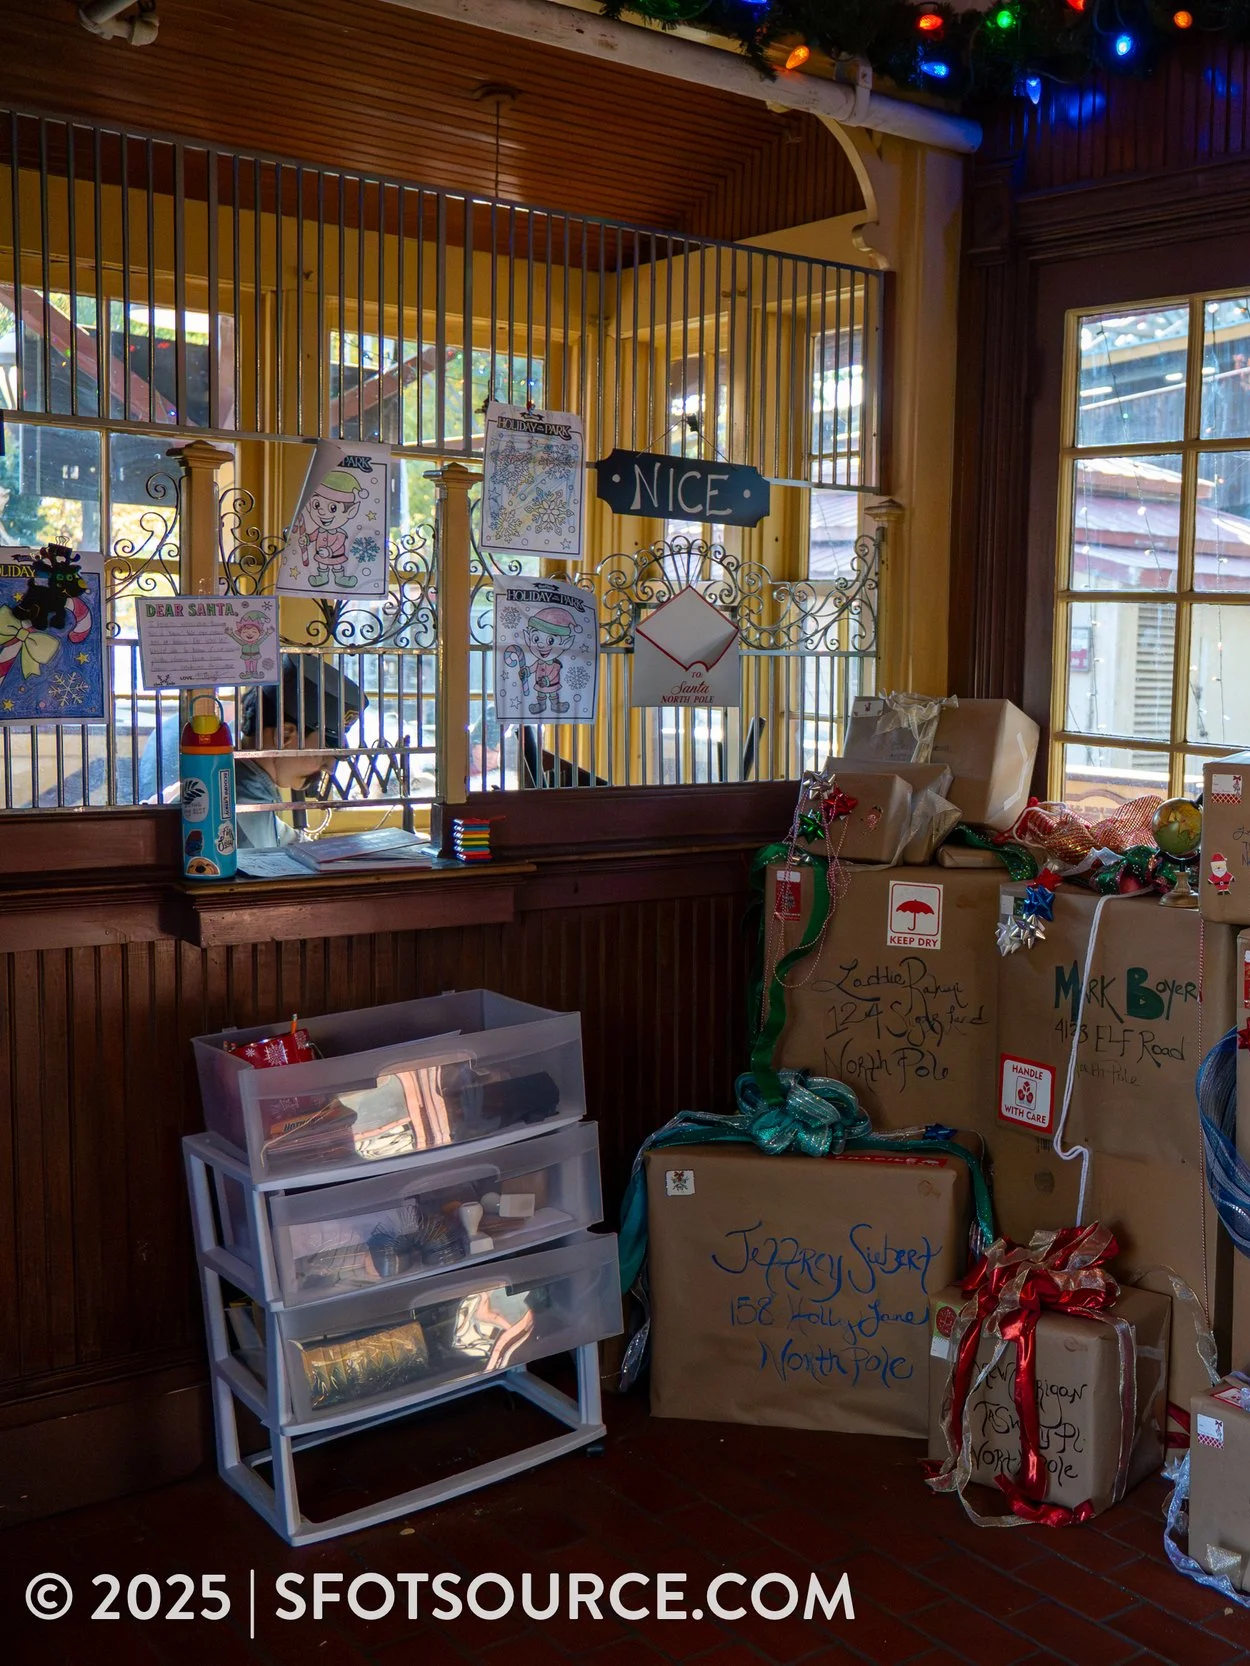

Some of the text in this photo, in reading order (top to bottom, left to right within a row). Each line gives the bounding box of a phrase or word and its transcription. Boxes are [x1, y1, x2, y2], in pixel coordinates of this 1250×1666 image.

[497, 415, 538, 434] HOLIDAY
[543, 423, 573, 442] PARK
[342, 455, 373, 473] PARK
[630, 461, 733, 517] NICE
[147, 602, 186, 618] DEAR
[506, 588, 586, 613] HOLIDAY PARK
[670, 680, 712, 695] Santa
[660, 694, 715, 704] NORTH POLE
[889, 935, 939, 948] KEEP DRY
[1136, 1030, 1185, 1068] Road
[1012, 1062, 1044, 1081] HANDLE
[1004, 1103, 1046, 1124] WITH CARE
[730, 1295, 775, 1326] 158
